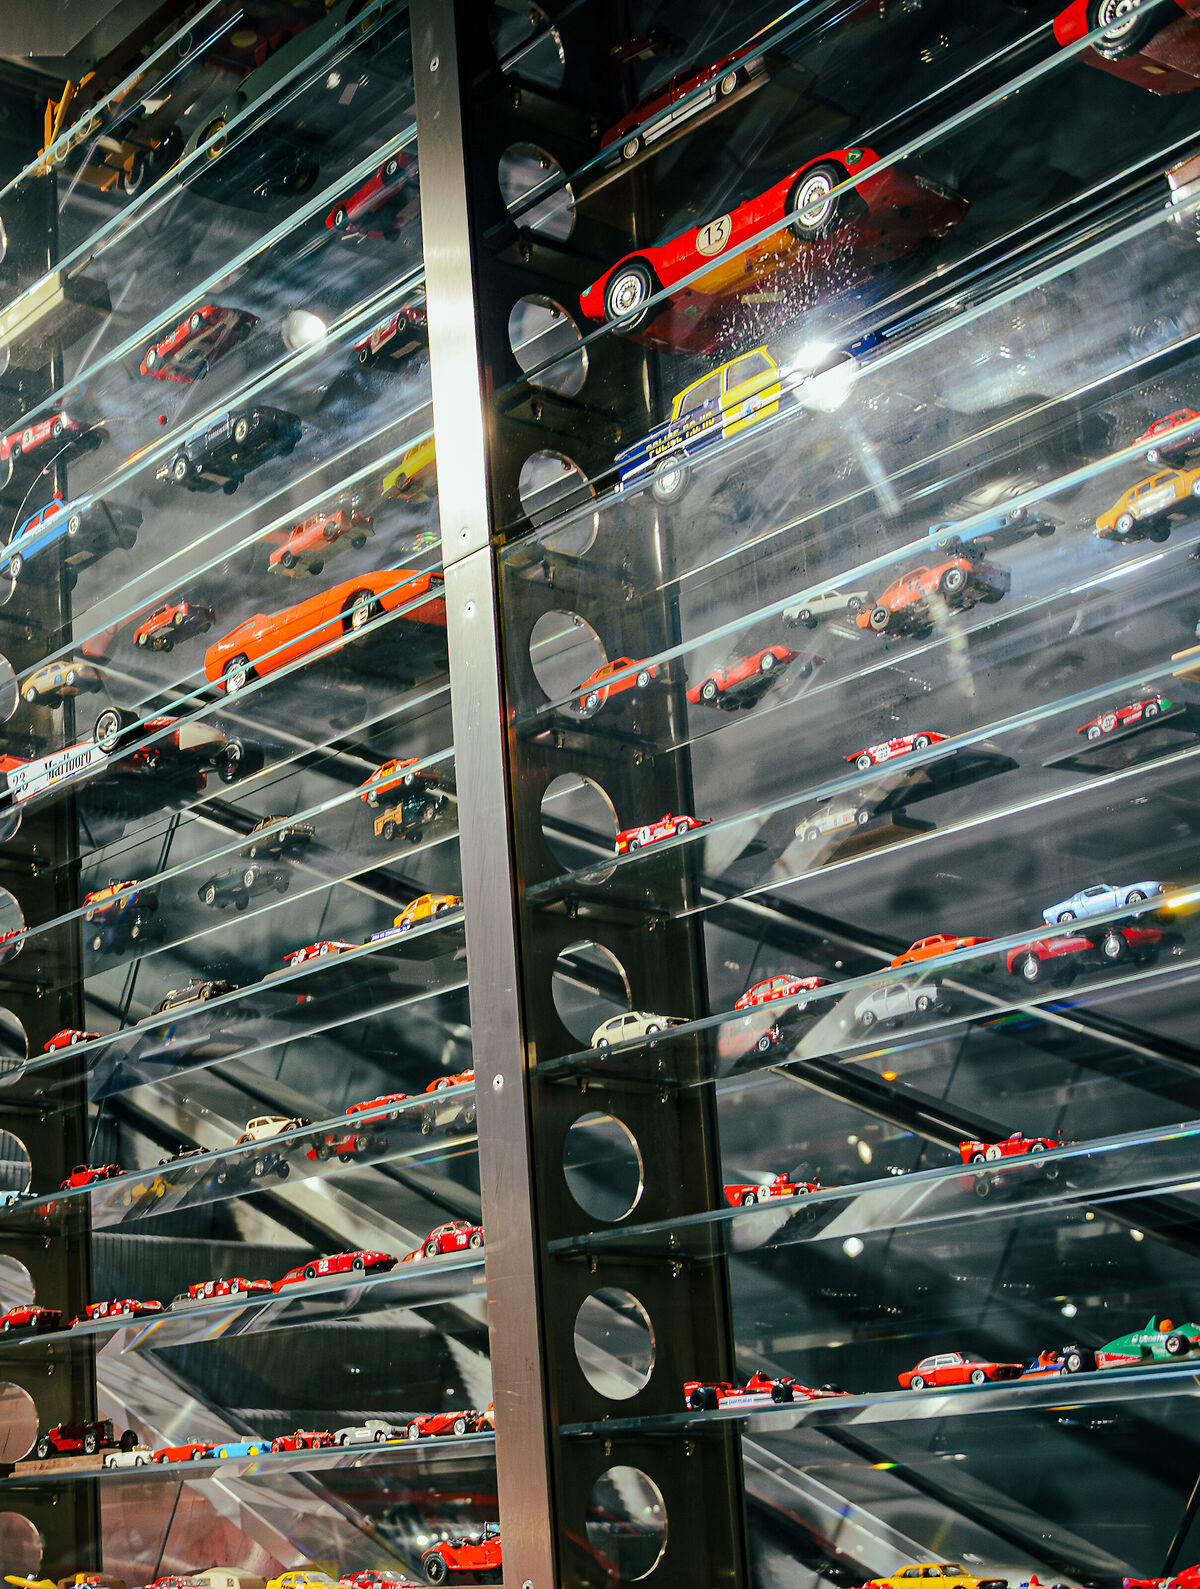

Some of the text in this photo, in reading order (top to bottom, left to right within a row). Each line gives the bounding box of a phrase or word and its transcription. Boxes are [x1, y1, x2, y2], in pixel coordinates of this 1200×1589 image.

[704, 219, 725, 246] 13
[44, 750, 92, 781] Marlboro
[318, 1259, 329, 1274] 22
